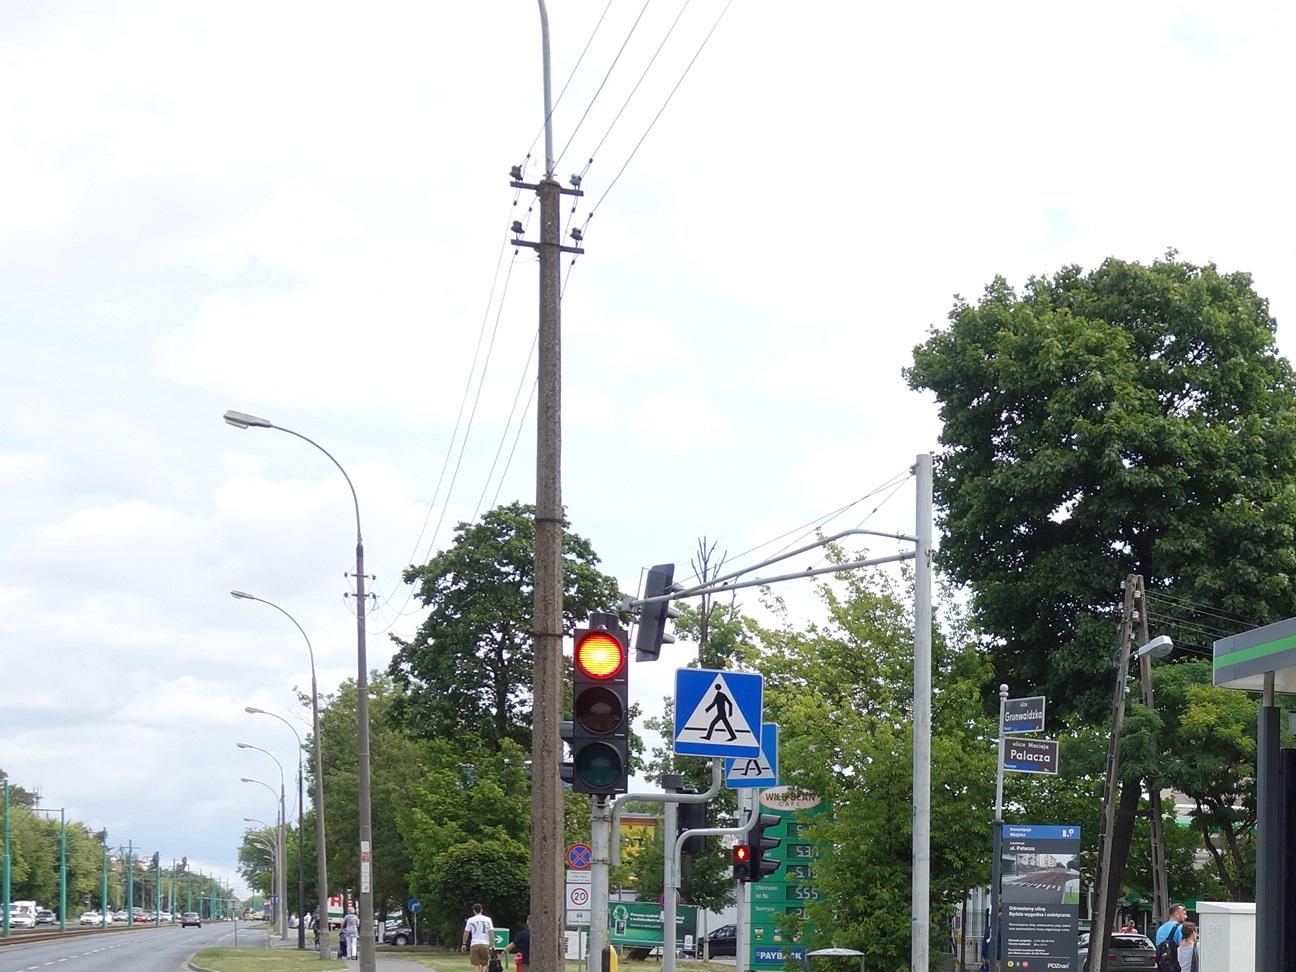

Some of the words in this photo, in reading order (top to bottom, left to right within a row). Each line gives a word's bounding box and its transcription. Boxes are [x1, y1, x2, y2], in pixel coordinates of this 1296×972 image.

[1004, 709, 1043, 722] Grunwaldzka
[1010, 749, 1051, 762] Palacza
[574, 892, 586, 901] 20
